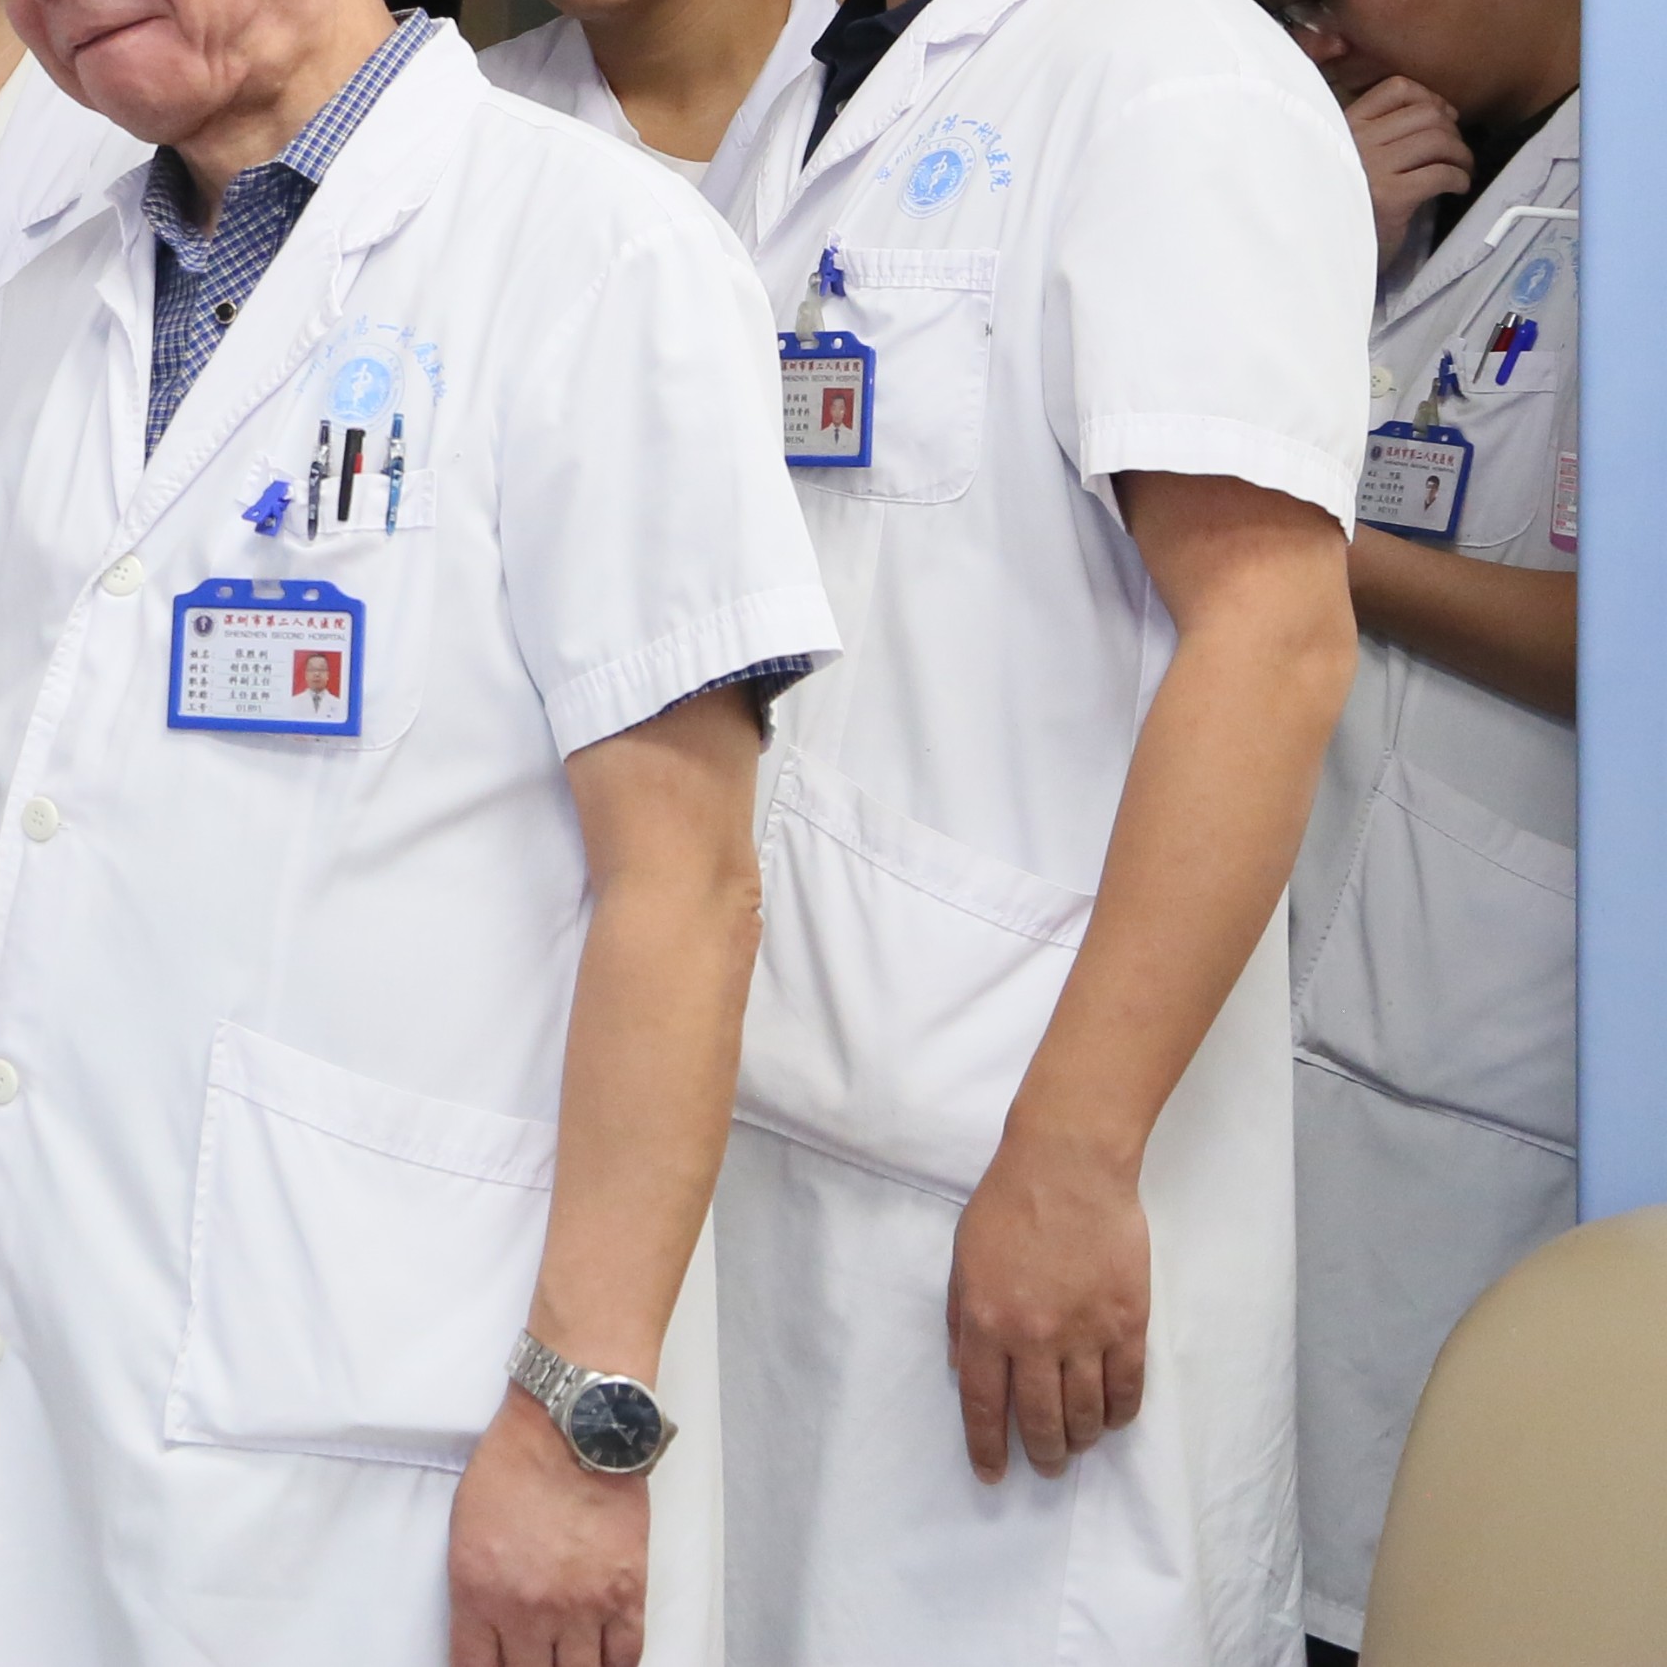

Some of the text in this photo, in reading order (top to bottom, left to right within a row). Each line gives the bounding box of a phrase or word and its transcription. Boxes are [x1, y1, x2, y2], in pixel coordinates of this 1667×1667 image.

[224, 614, 345, 630] 深圳市第二人民医院
[225, 630, 347, 641] SHENZHEN SECOND HOSPITAL
